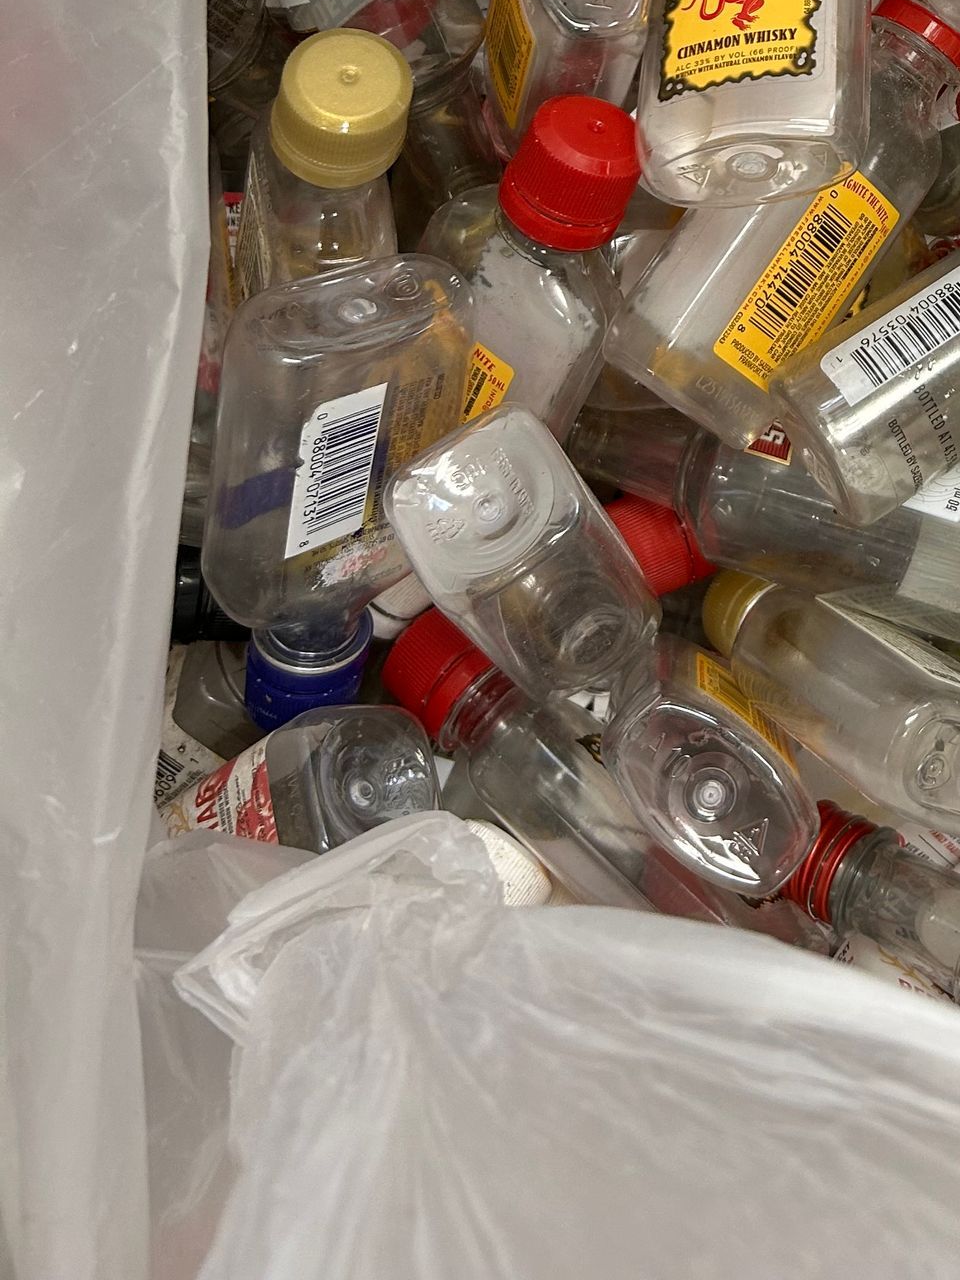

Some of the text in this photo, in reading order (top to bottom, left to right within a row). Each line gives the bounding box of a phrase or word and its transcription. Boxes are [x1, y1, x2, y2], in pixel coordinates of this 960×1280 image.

[675, 25, 798, 60] CINNAMON WHISKY
[674, 63, 694, 72] ALC
[694, 58, 712, 68] 33%
[713, 53, 727, 63] BY
[727, 50, 745, 60] VOL
[697, 63, 714, 73] WITH
[713, 59, 741, 69] NATURAL
[741, 53, 774, 65] CINNAMON
[841, 174, 895, 224] IGNITE THE NITE
[734, 188, 840, 334] 0 88004 14470 8
[908, 280, 956, 317] 88004
[858, 312, 907, 349] 03576
[470, 347, 498, 373] NITE
[833, 354, 843, 364] 1
[486, 373, 507, 392] 50ML
[913, 382, 953, 444] BOTTLED AT
[886, 418, 917, 468] BOTTLED BY
[298, 411, 328, 549] 0 88004 07131 8
[944, 497, 959, 511] 50
